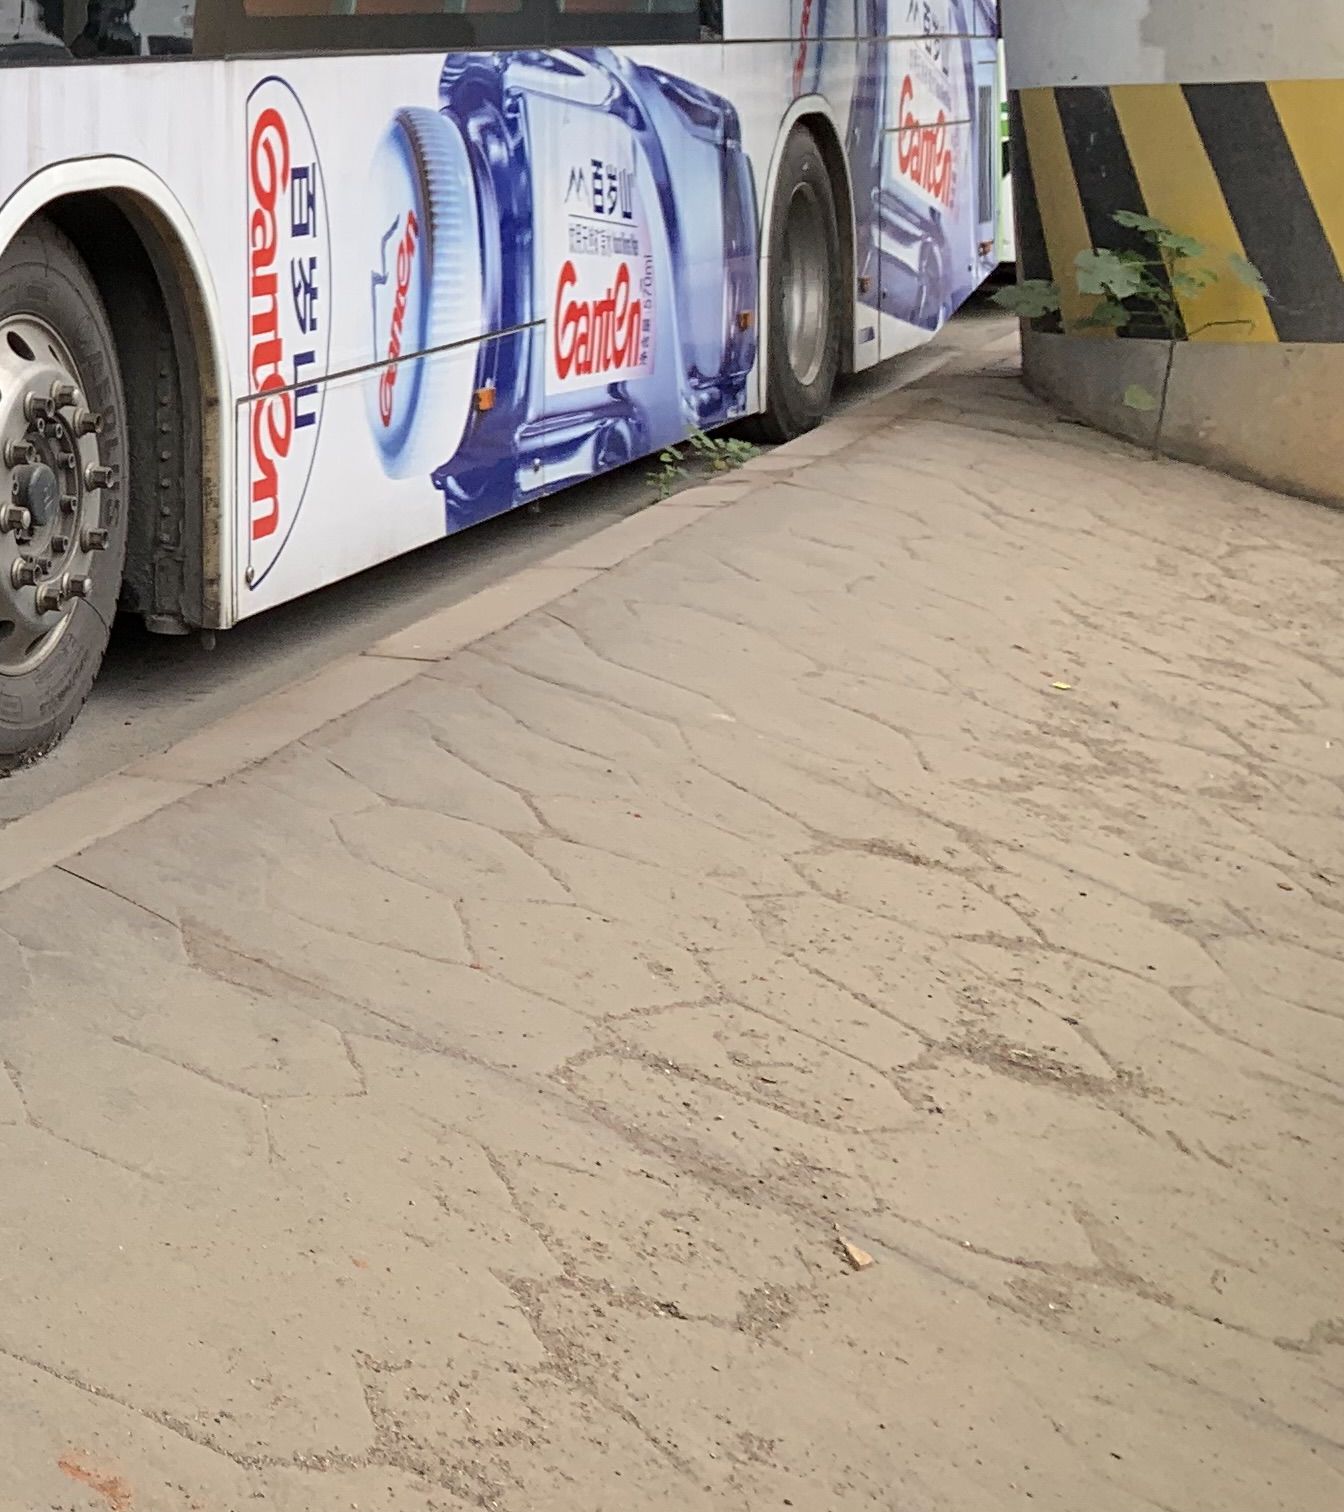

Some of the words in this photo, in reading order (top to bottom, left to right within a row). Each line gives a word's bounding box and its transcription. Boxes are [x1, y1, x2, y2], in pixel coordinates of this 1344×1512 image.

[590, 158, 634, 220] 百岁山
[898, 73, 952, 208] Ganten
[250, 107, 291, 540] Ganten
[291, 162, 318, 429] 百岁山
[554, 260, 641, 381] Ganten
